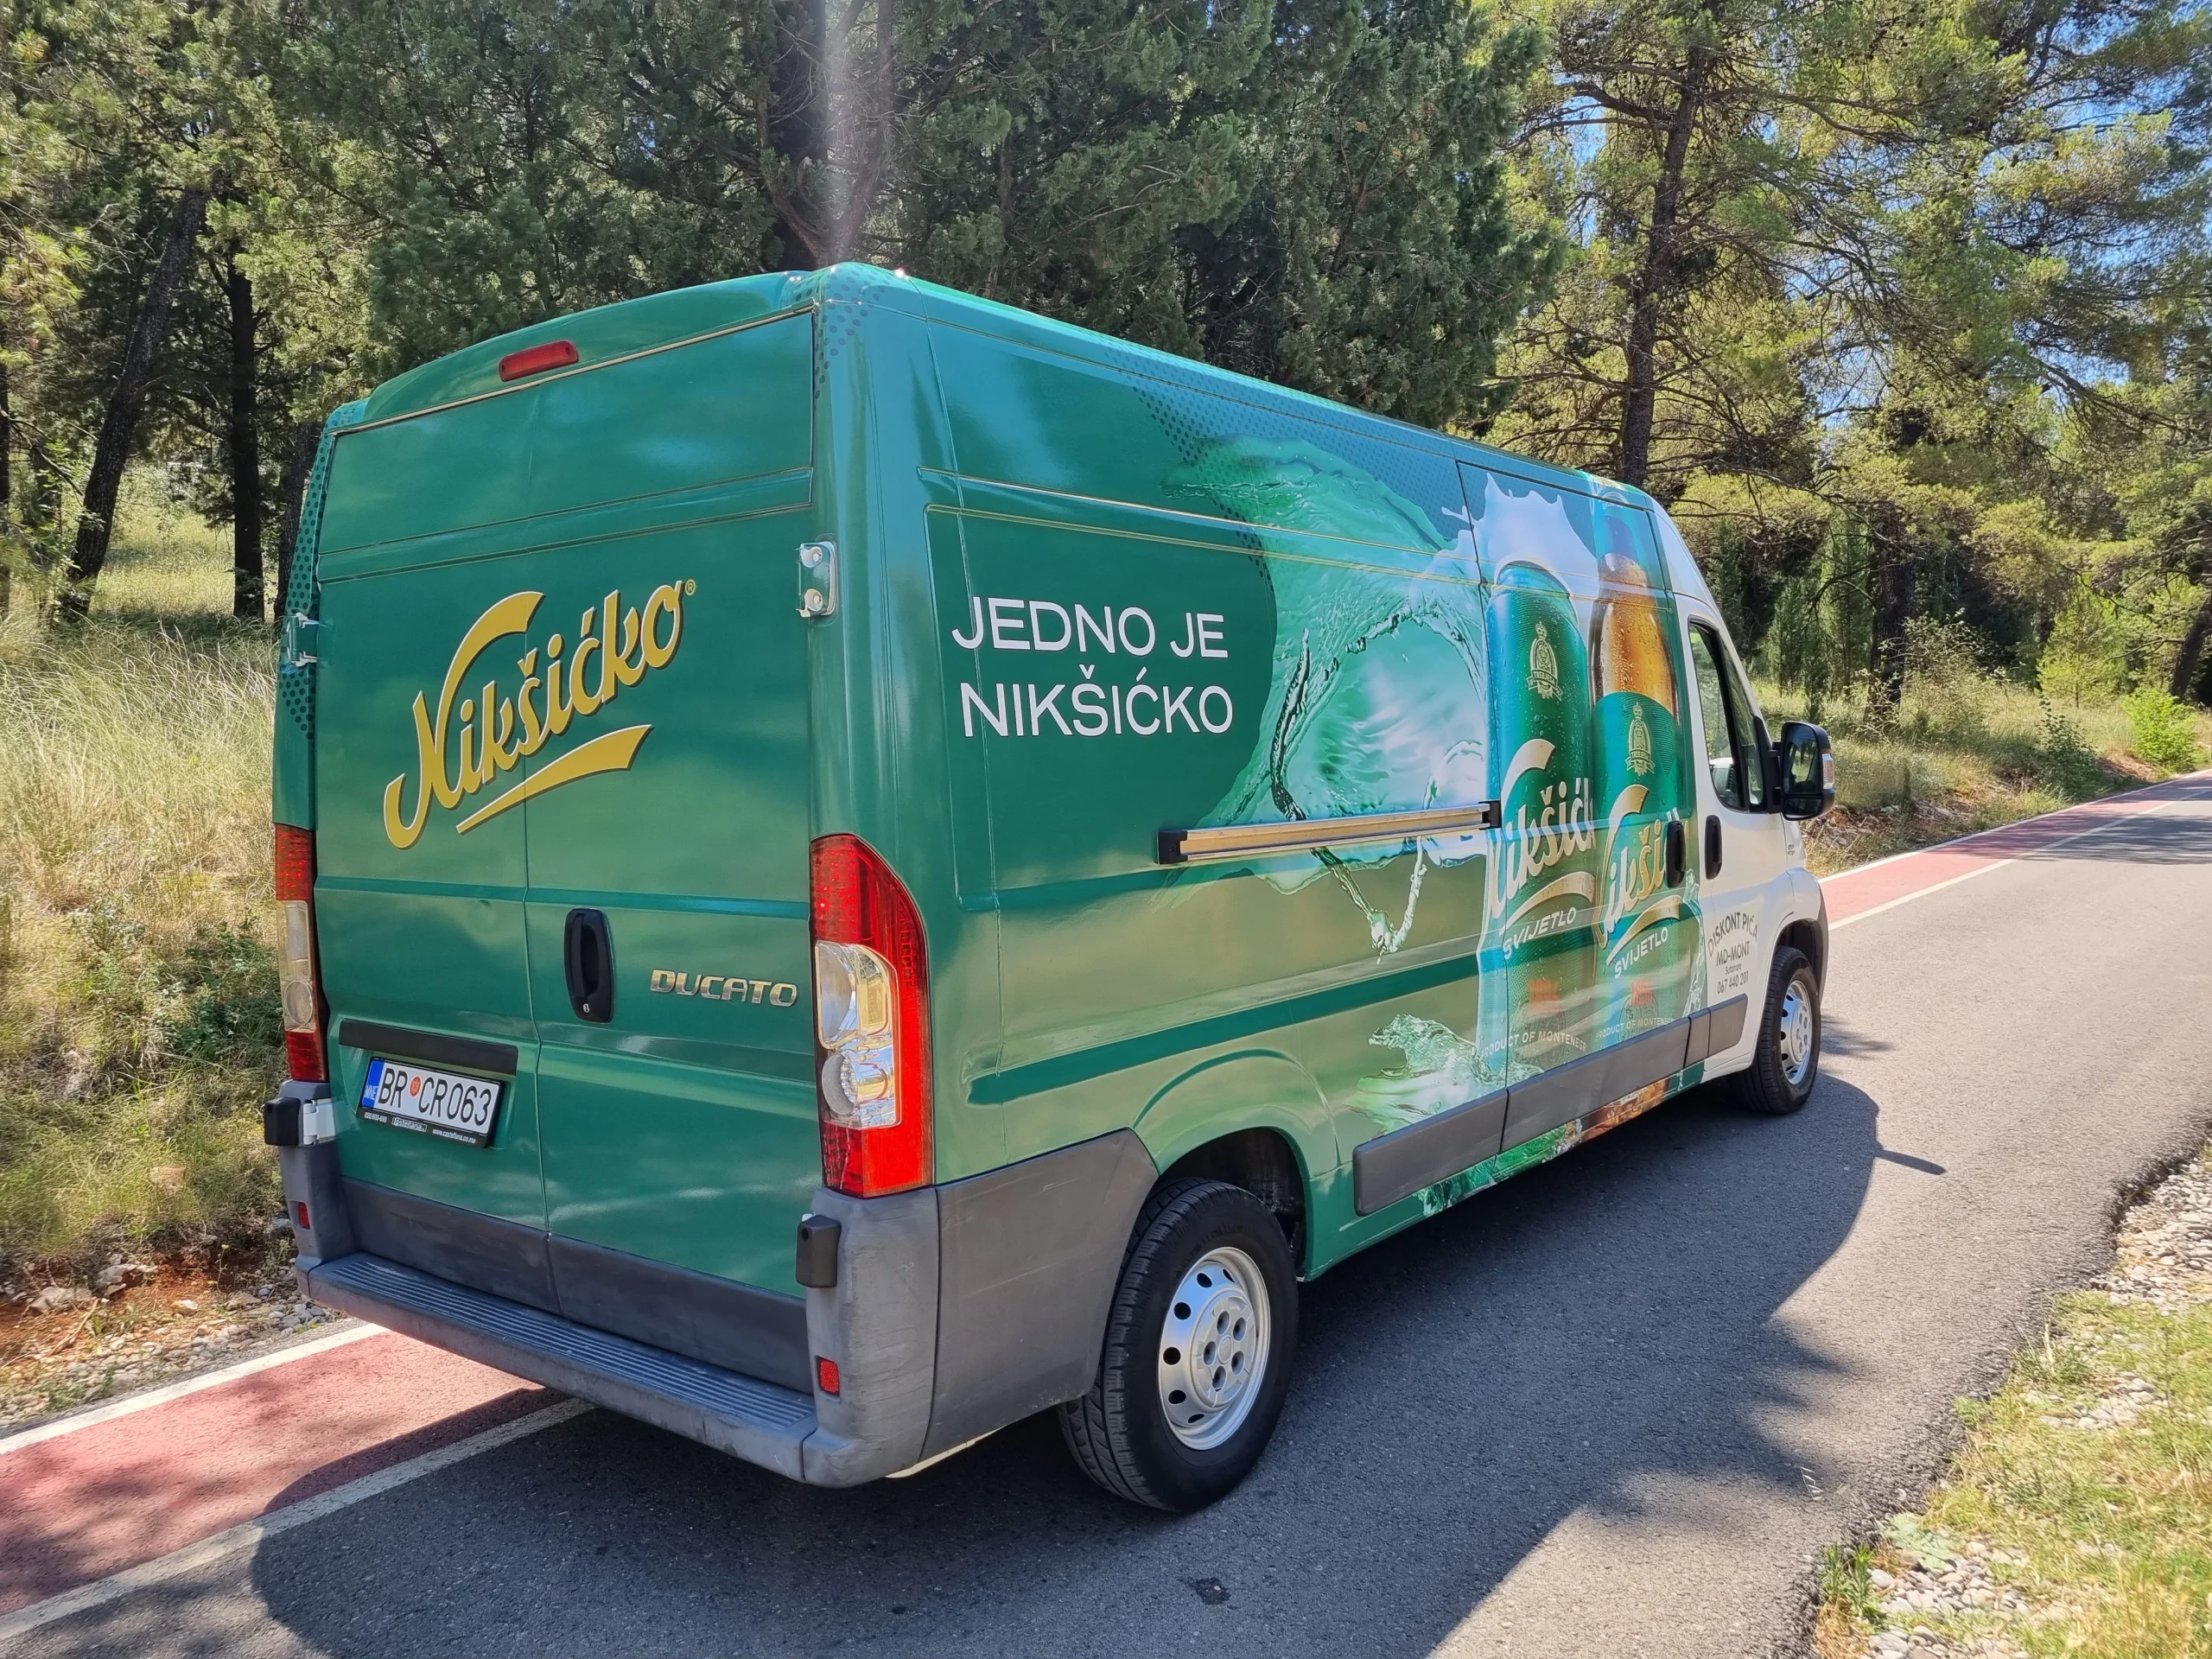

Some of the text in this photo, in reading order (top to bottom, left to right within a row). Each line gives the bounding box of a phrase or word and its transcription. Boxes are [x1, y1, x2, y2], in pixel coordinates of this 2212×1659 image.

[951, 596, 1230, 659] JEDNO JE
[960, 664, 1234, 737] NIKŠIĆKO
[1502, 906, 1577, 960] SVIJETLO
[1614, 926, 1669, 979] SVIJETLO
[1707, 912, 1741, 957] DISKONT
[1716, 941, 1751, 967] MD-MONT
[650, 969, 799, 1007] DUCATO
[1717, 979, 1728, 995] 067
[1729, 975, 1738, 989] 440
[1481, 1033, 1520, 1058] PRODUCT
[1522, 1032, 1535, 1044] OF
[1626, 1020, 1636, 1030] OF
[364, 1084, 378, 1100] MNE
[378, 1068, 493, 1126] BR CR063
